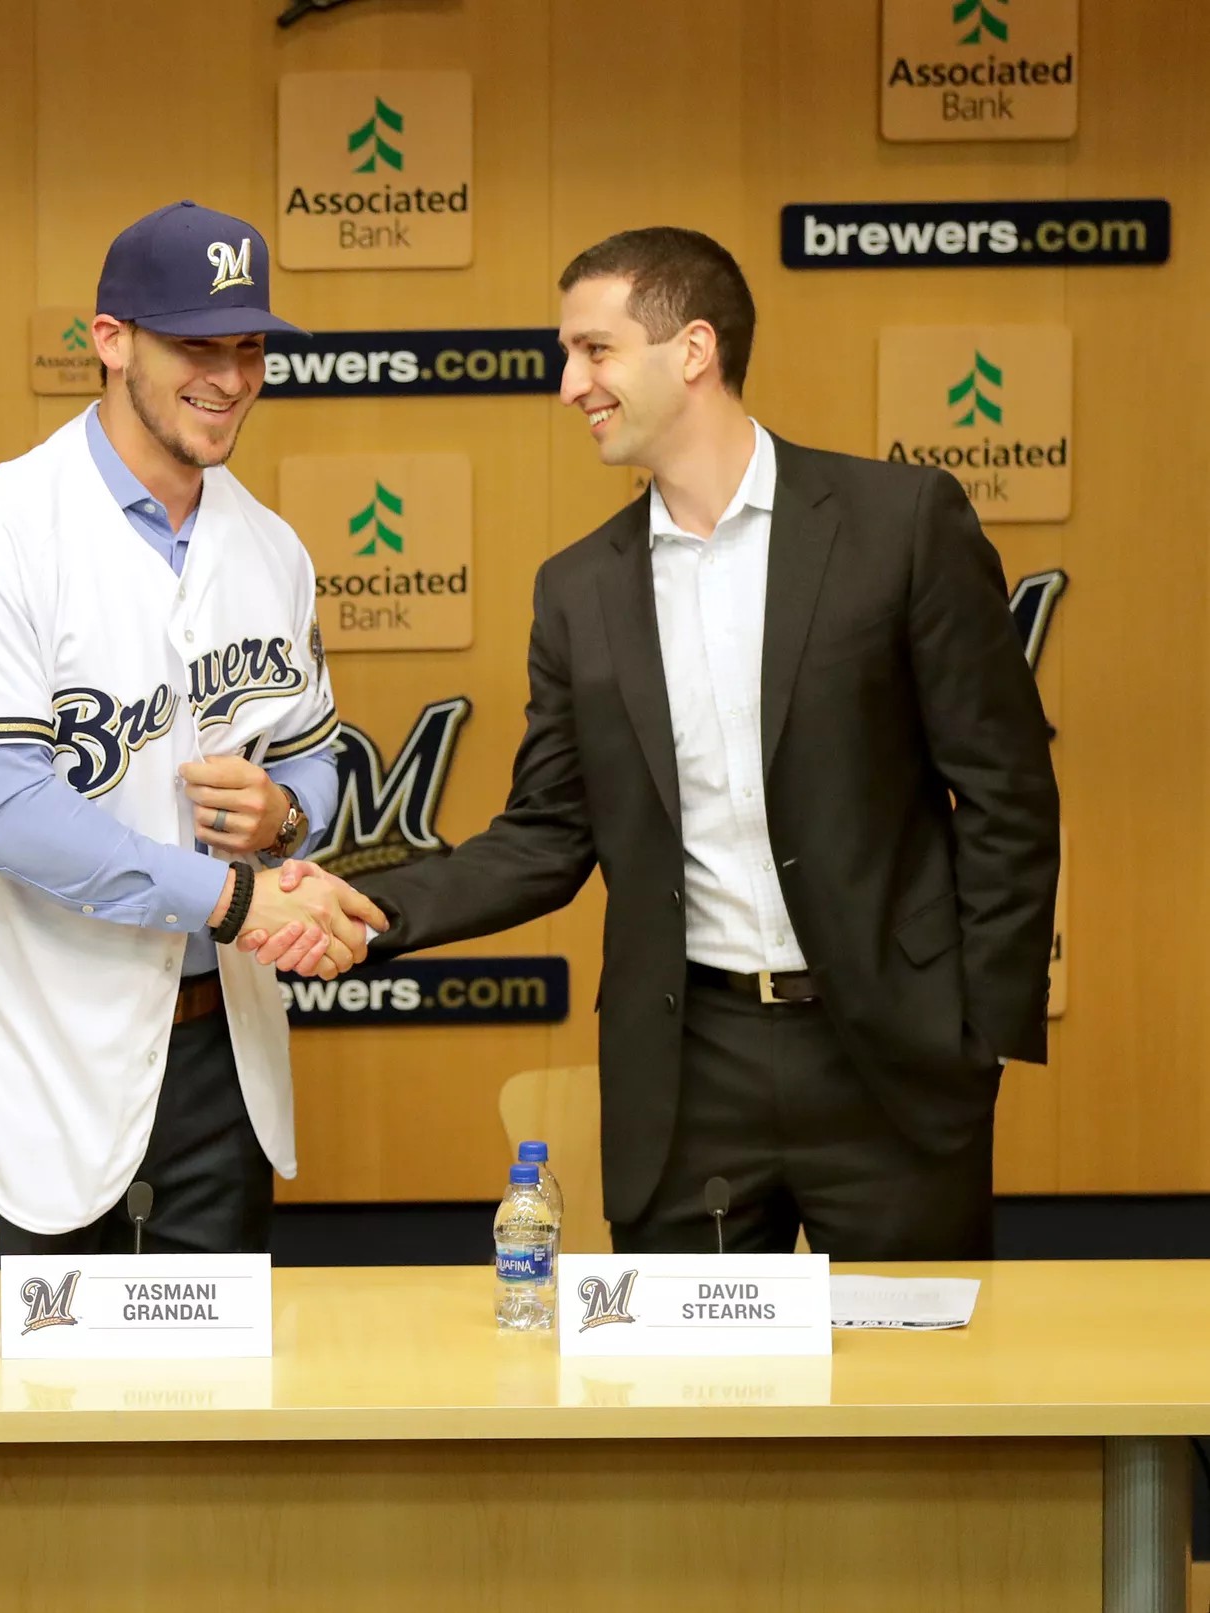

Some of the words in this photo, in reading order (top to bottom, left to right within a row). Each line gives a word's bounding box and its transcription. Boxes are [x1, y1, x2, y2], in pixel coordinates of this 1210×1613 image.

[888, 53, 1073, 87] Associated
[942, 89, 1014, 121] Bank
[286, 182, 468, 216] Associated
[339, 218, 411, 249] Bank
[804, 215, 1147, 256] brewers.com
[207, 238, 252, 288] M
[264, 349, 545, 385] ewers.com
[887, 437, 1067, 468] Associated
[964, 472, 1009, 501] ank
[315, 564, 468, 597] ssociated
[339, 600, 412, 631] Bank
[280, 977, 547, 1012] wers.com
[124, 1283, 217, 1300] YASMANI
[698, 1283, 759, 1299] DAVID
[123, 1304, 219, 1321] GRANDAL
[682, 1303, 776, 1320] STEARNS
